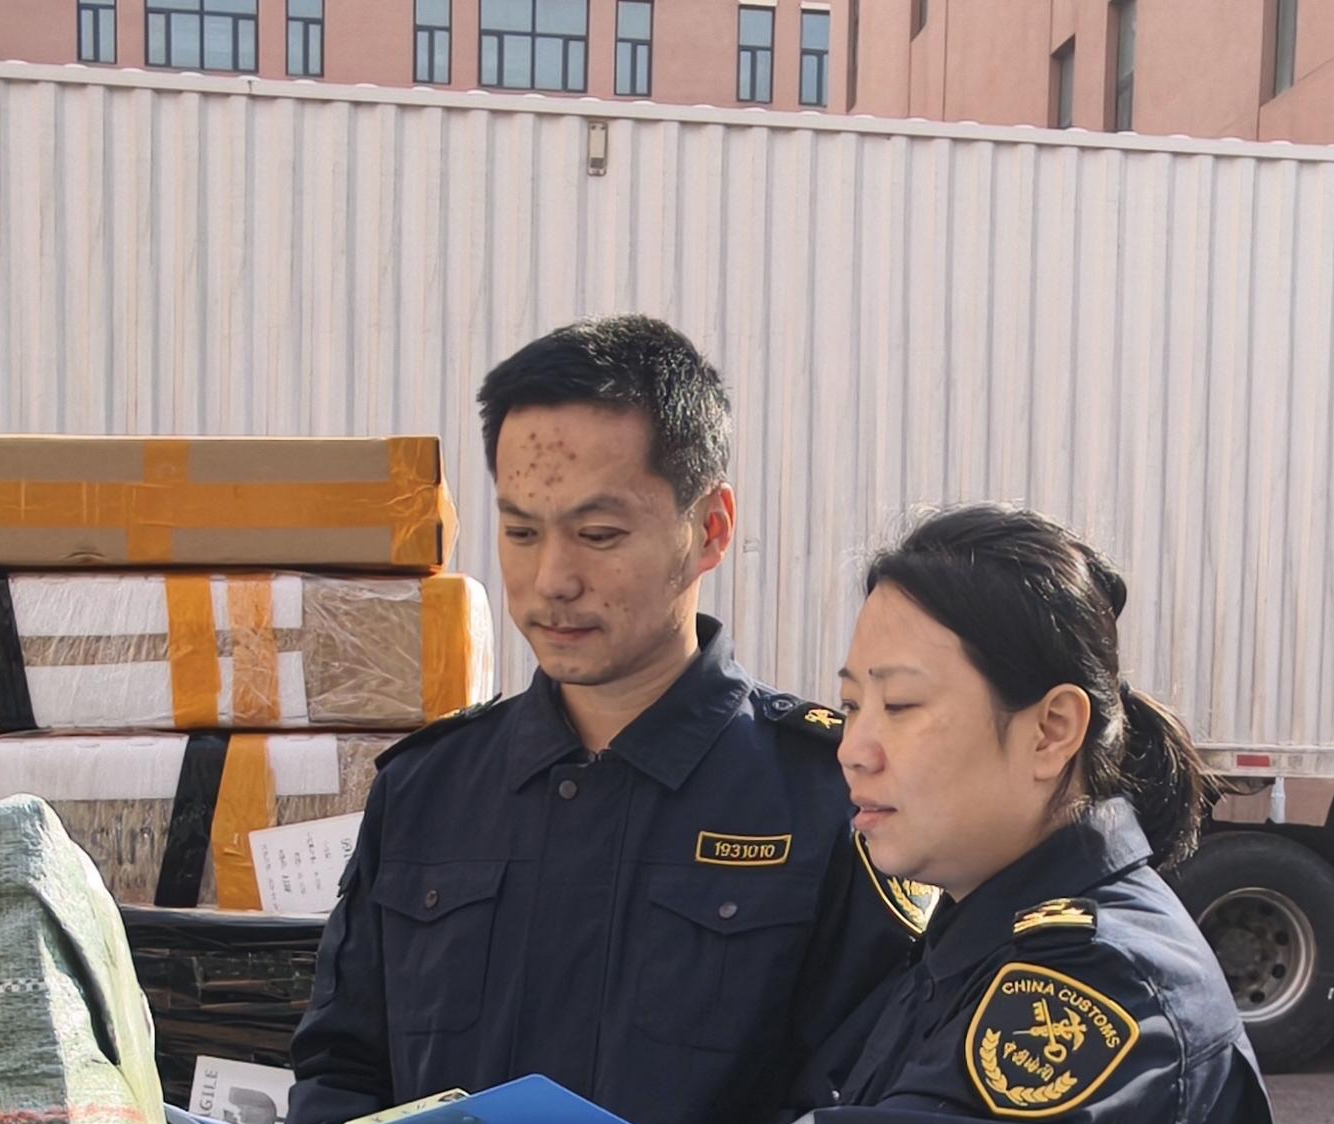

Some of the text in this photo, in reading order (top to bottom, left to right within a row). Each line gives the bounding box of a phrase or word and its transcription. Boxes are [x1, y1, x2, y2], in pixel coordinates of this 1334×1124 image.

[714, 840, 776, 859] 1931010
[1001, 979, 1121, 1049] CHINA CUSTOMS
